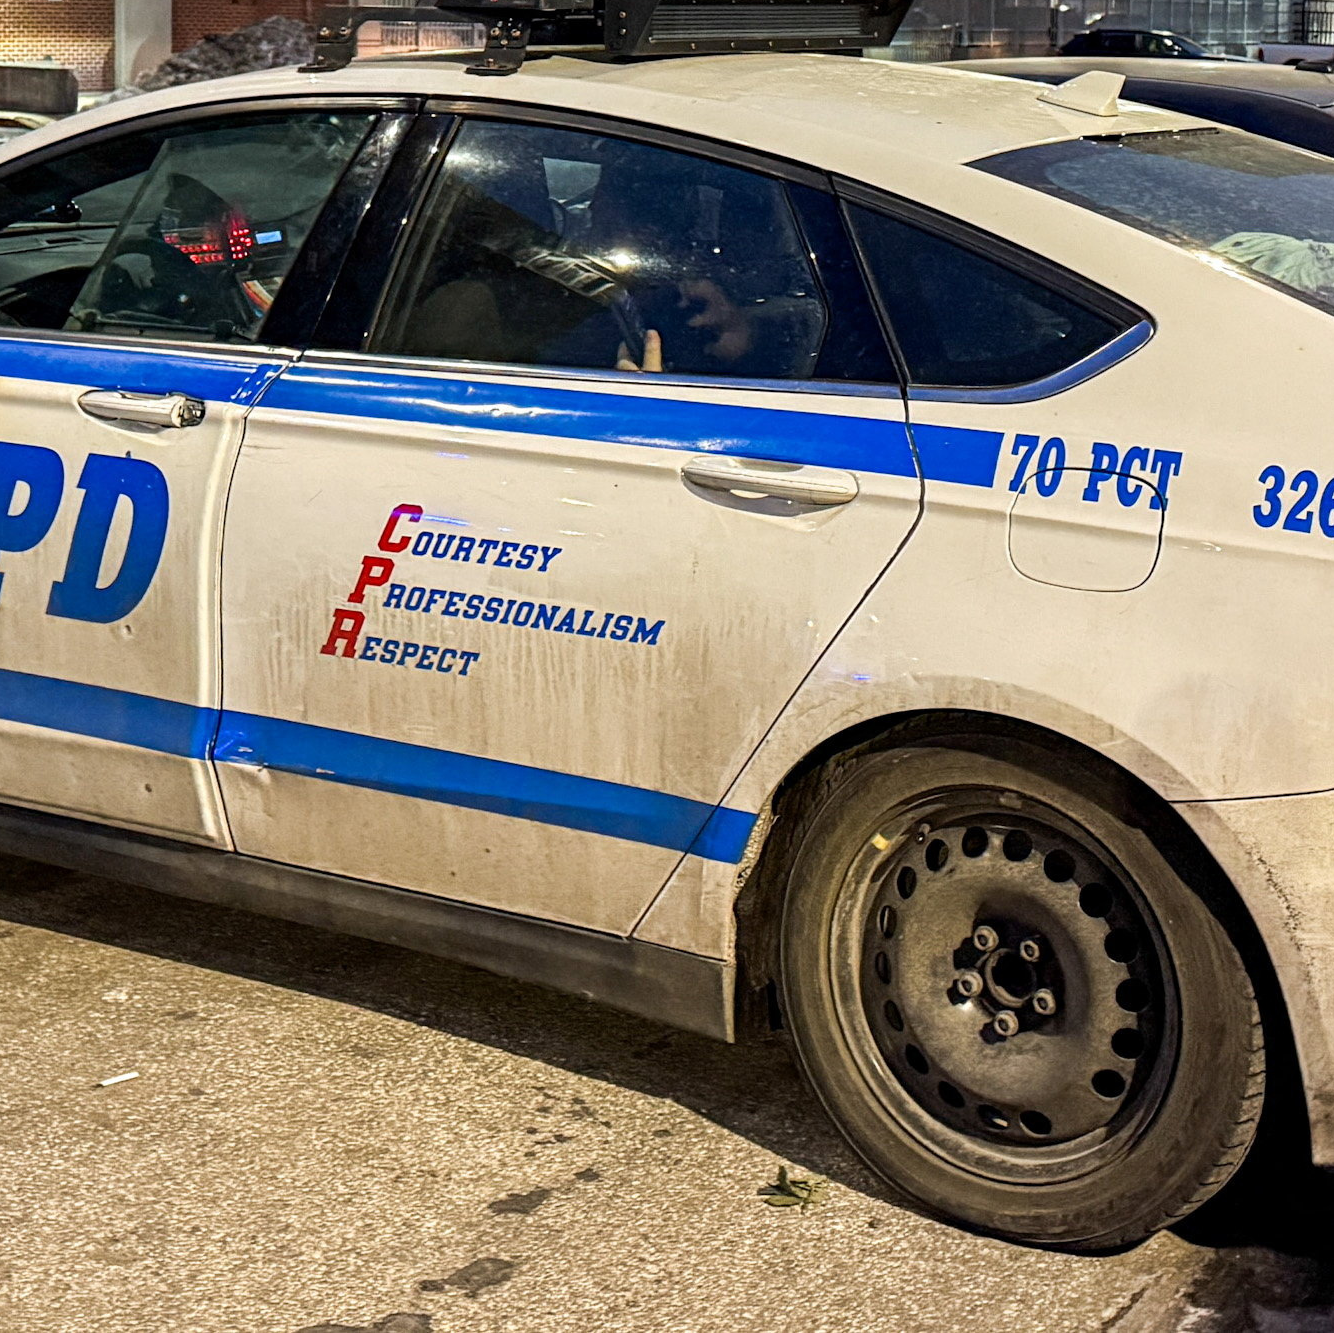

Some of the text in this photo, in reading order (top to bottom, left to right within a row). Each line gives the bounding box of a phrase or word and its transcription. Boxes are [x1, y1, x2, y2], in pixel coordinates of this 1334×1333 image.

[1009, 433, 1183, 511] 70 PCT
[377, 503, 563, 573] COURTESY
[347, 555, 666, 646] PROFESSIONALISM
[320, 608, 480, 676] RESPECT
